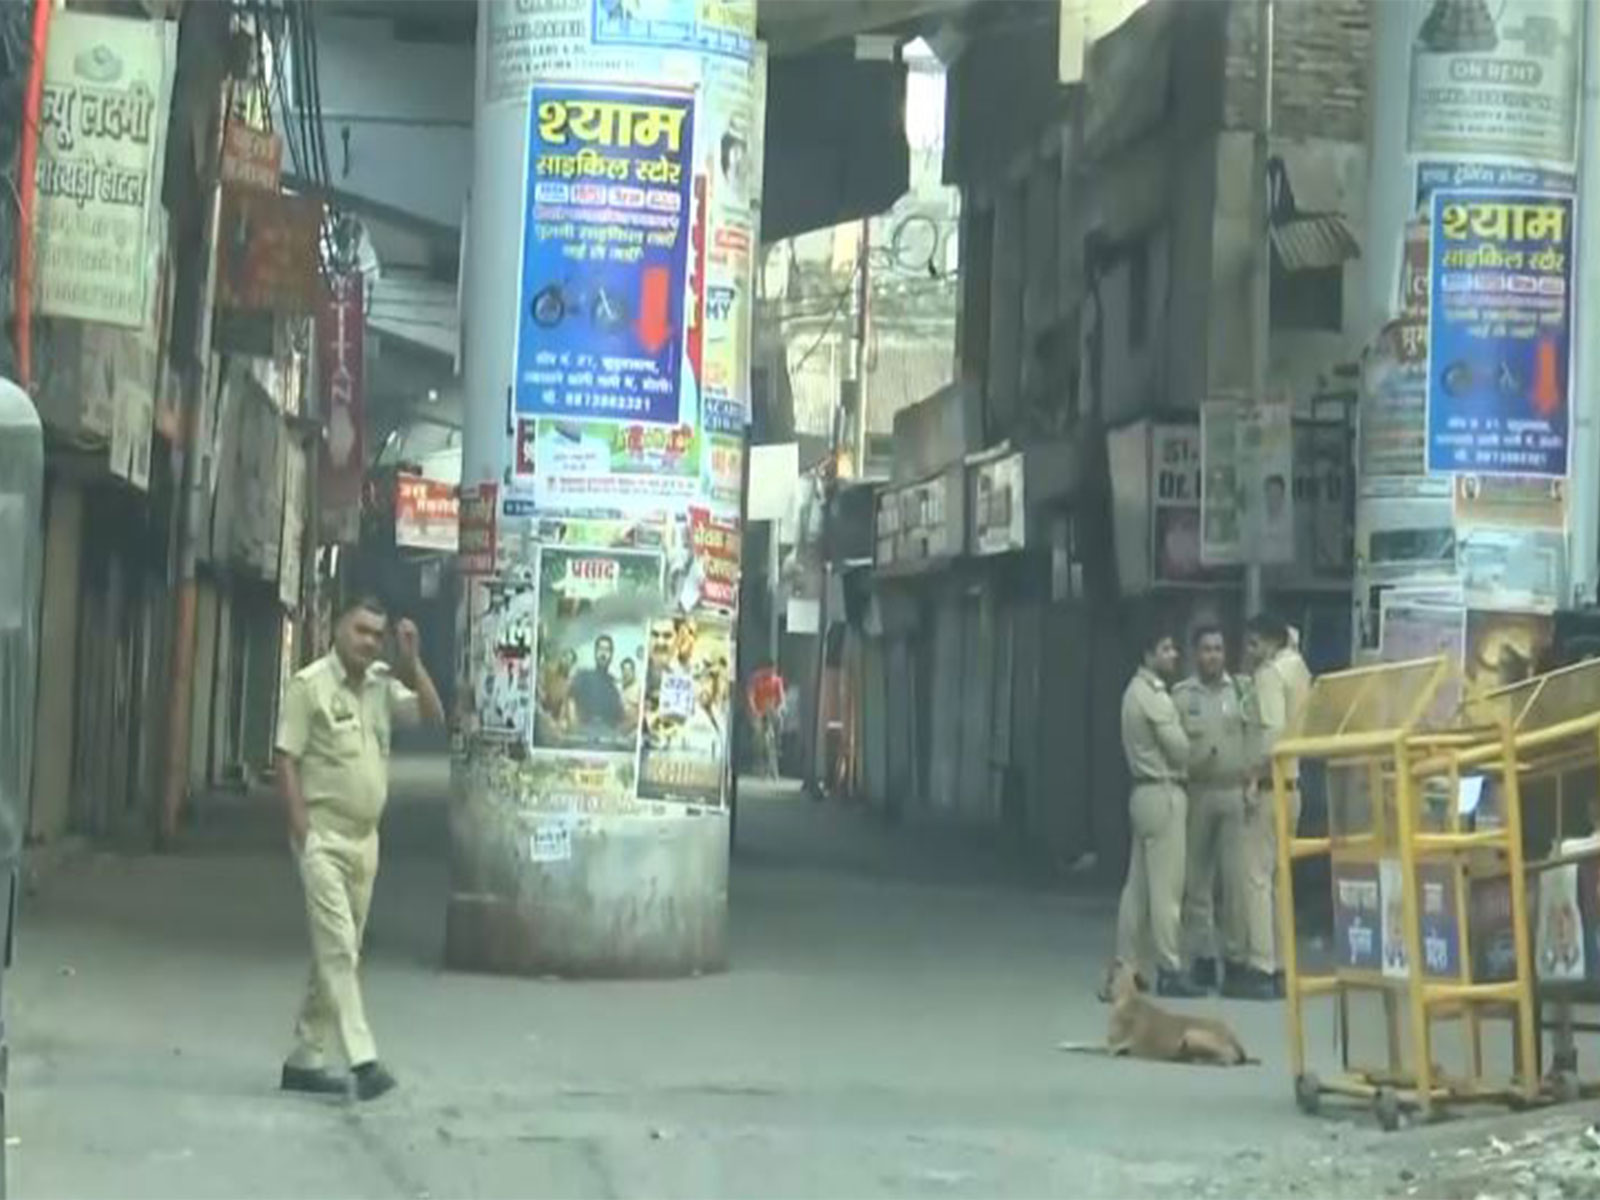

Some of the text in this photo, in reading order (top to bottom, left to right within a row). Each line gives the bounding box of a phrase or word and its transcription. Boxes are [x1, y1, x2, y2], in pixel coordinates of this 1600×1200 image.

[1454, 61, 1537, 82] ON RENT
[538, 98, 687, 151] श्याम
[536, 148, 682, 184] साइकिल स्टोर
[1442, 203, 1567, 242] श्याम
[1442, 242, 1565, 272] साइकिल स्टोर
